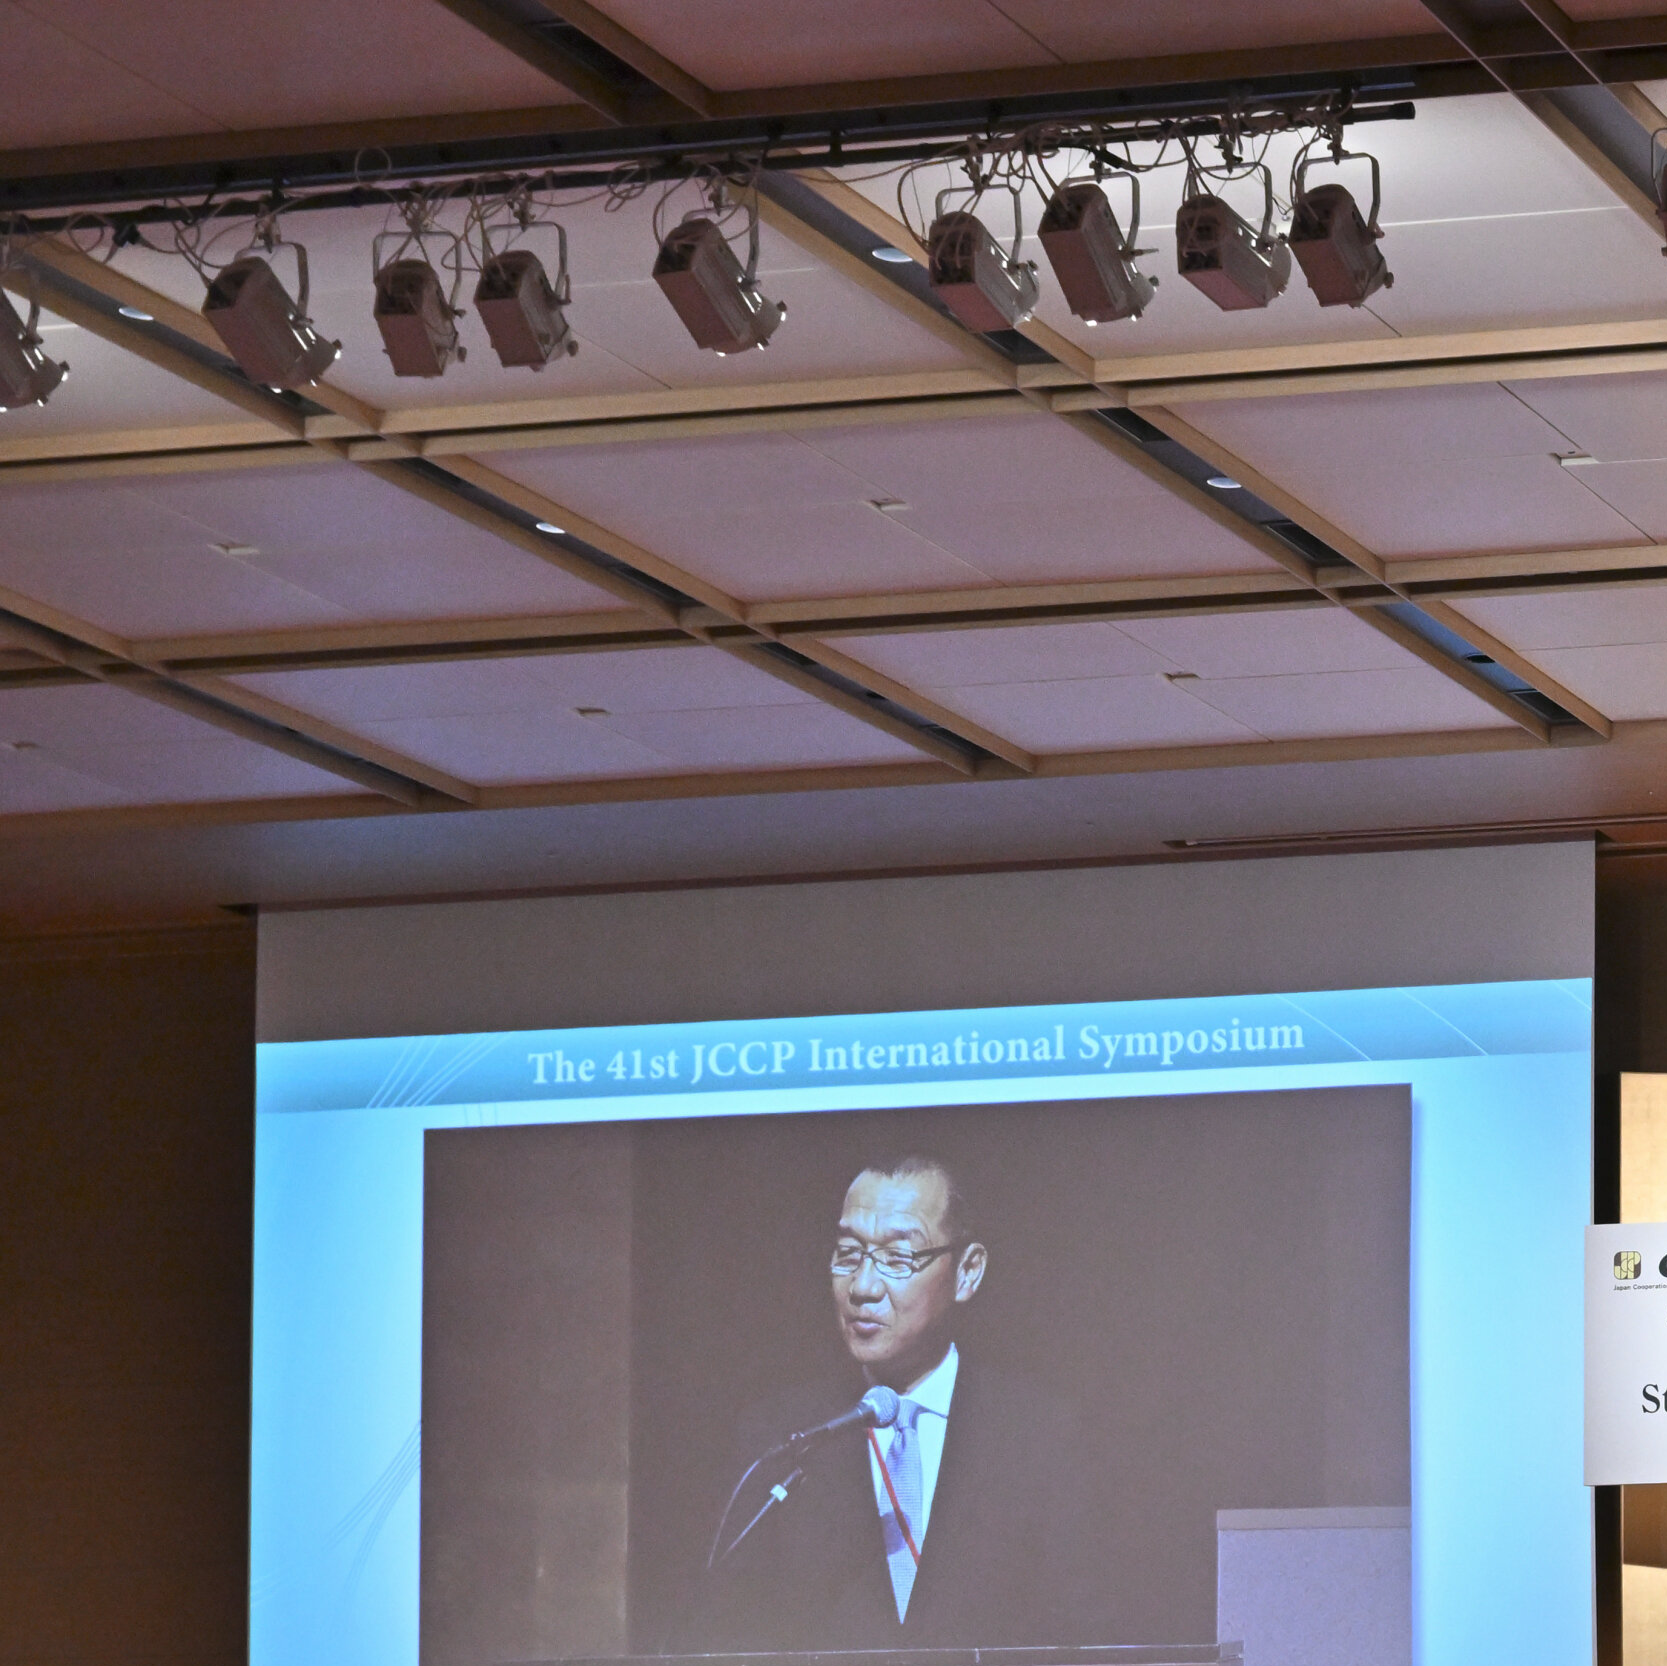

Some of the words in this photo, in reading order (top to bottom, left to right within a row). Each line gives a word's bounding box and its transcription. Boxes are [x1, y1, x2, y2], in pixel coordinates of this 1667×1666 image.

[528, 1050, 595, 1083] The
[607, 1050, 678, 1080] 41st
[691, 1041, 795, 1084] JCCP
[809, 1025, 1065, 1071] International
[1079, 1018, 1304, 1068] Symposium
